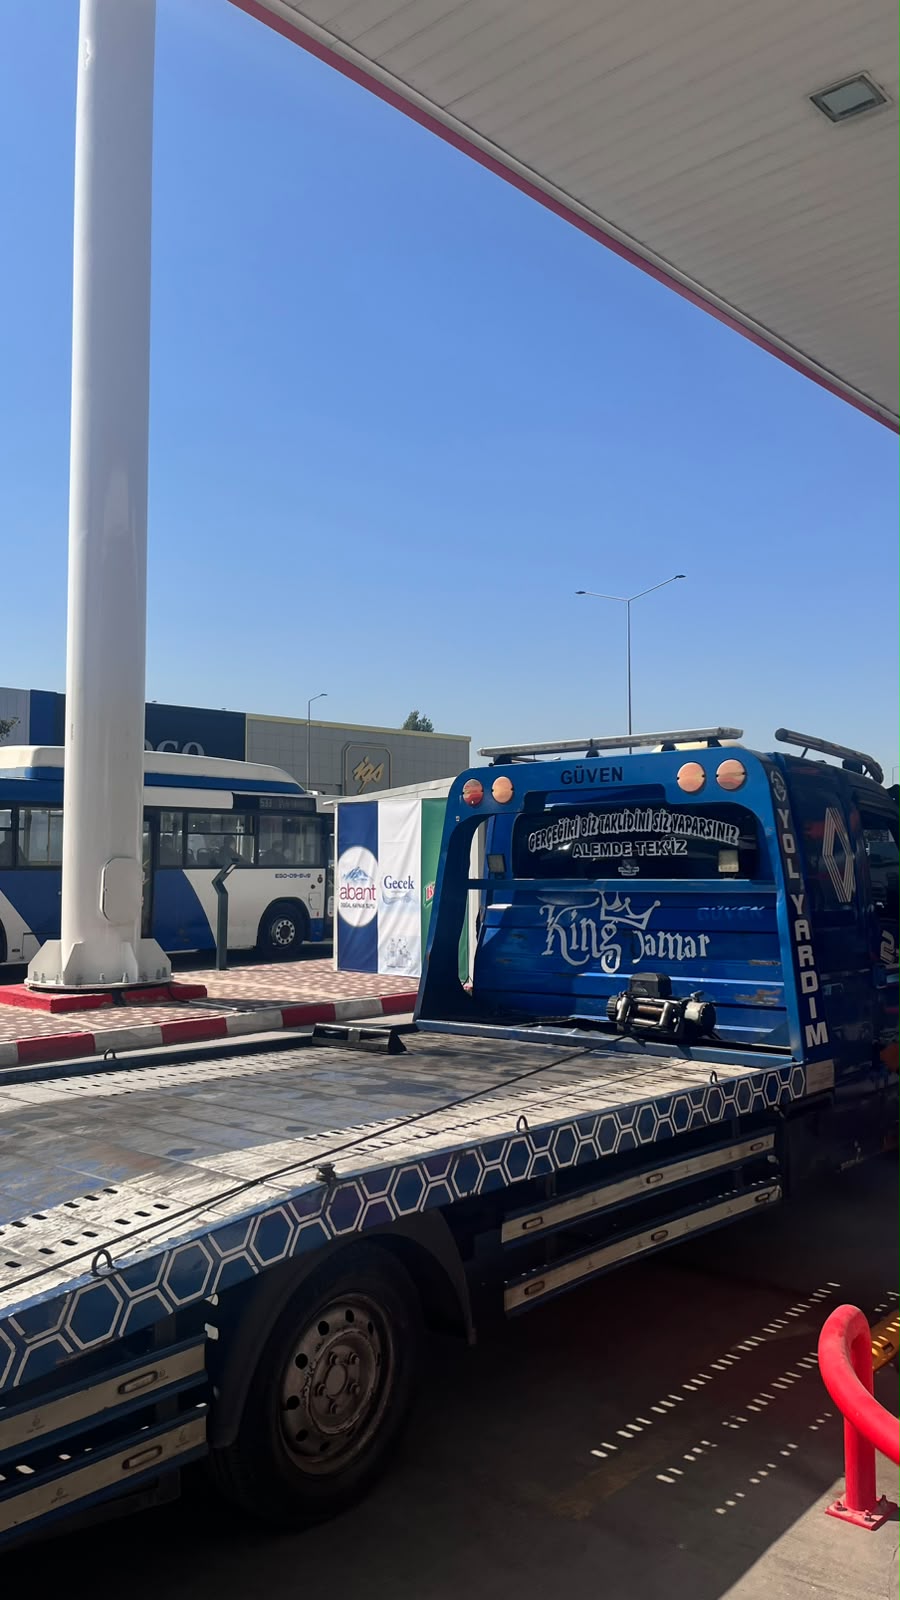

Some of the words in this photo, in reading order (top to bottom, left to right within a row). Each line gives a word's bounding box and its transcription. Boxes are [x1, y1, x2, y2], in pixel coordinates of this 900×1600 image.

[561, 765, 623, 785] GÜVEN
[580, 812, 599, 837] BİZ
[599, 808, 653, 834] TAKLİDİNİ
[652, 808, 672, 833] SİZ
[671, 813, 740, 846] YAPARSINIZ
[572, 841, 633, 858] ALEMDE
[340, 883, 377, 901] abant
[383, 875, 415, 890] Gecek
[539, 896, 622, 974] King
[777, 808, 800, 879] YOL
[790, 893, 829, 1048] YARDIM
